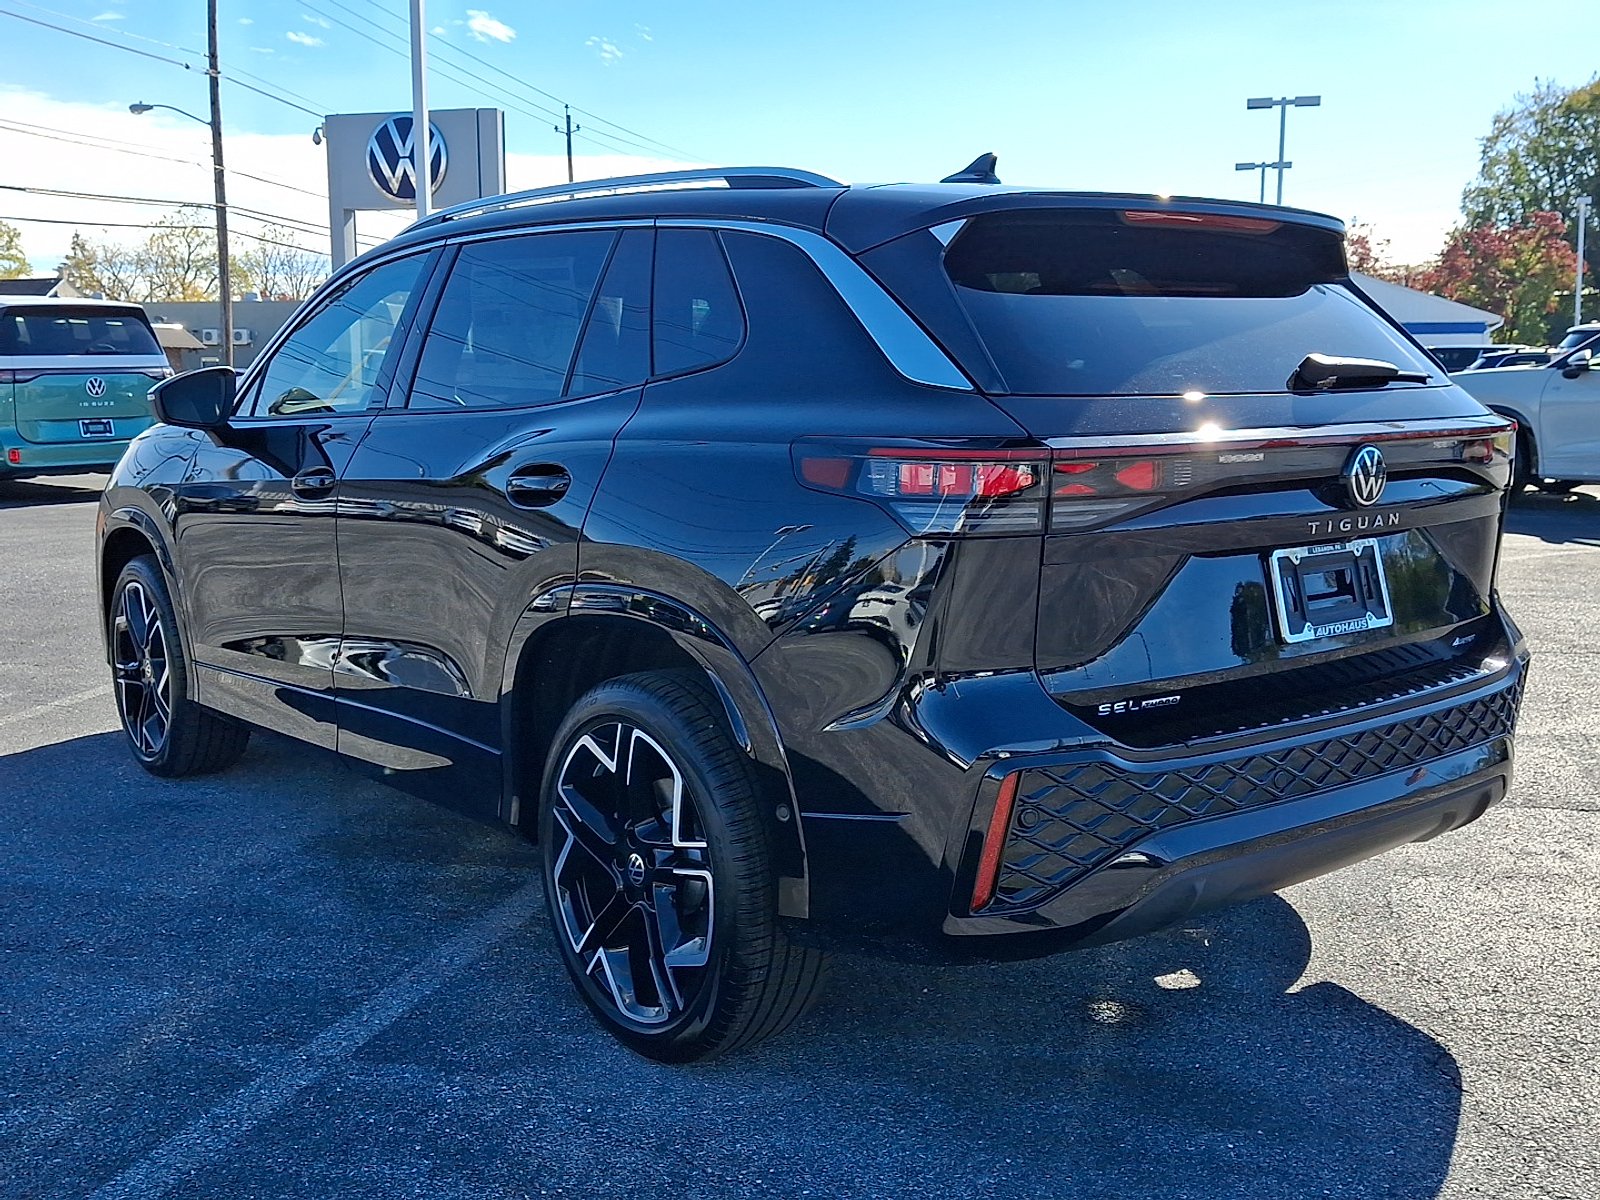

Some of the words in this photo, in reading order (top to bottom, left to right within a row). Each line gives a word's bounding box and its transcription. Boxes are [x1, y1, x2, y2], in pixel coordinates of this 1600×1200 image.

[1351, 446, 1387, 505] VW
[1308, 512, 1400, 535] TIGUAN
[1316, 619, 1368, 637] AUTOHAUS
[1098, 700, 1139, 716] SEL
